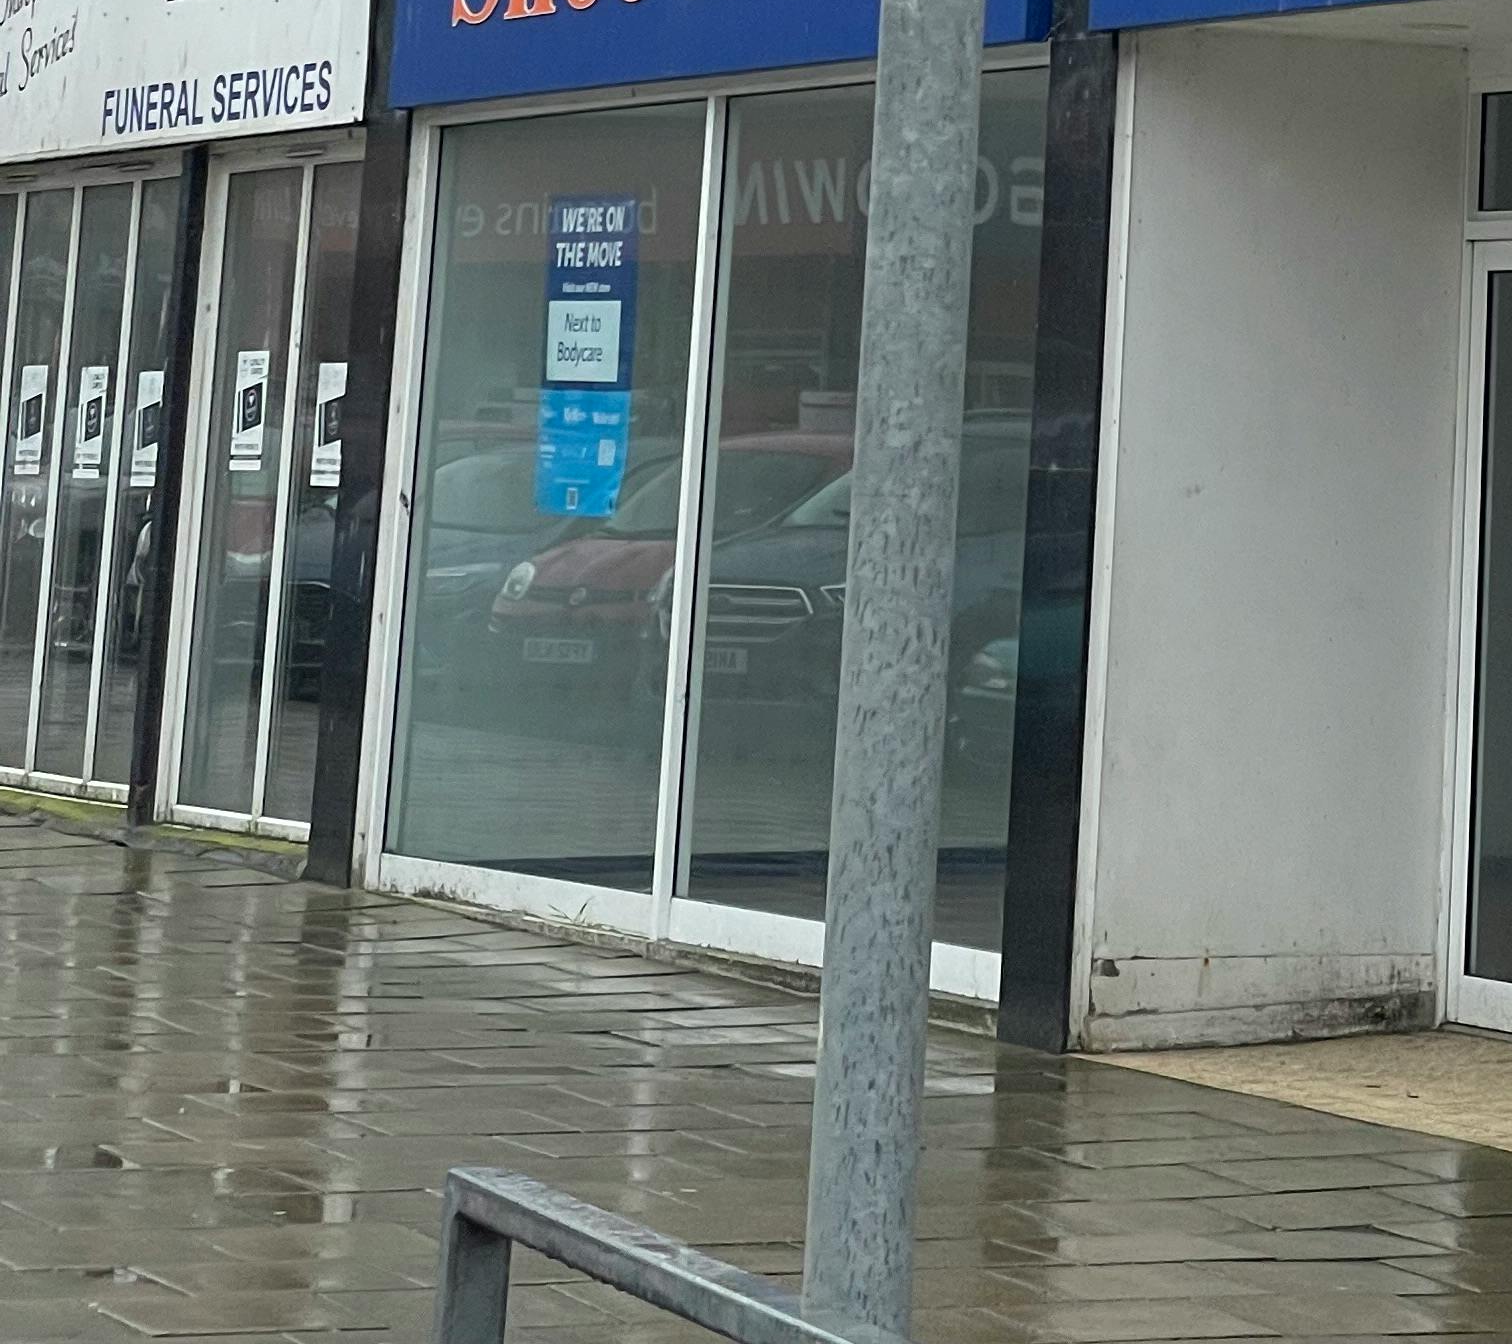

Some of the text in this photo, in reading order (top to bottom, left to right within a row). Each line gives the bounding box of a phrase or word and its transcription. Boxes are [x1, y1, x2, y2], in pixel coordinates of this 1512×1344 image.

[102, 60, 332, 136] FUNERAL SERVICES
[562, 207, 604, 233] WE'RE
[606, 206, 626, 232] ON
[556, 241, 623, 268] THE MOVE
[565, 313, 601, 333] Next to
[557, 342, 603, 367] Bodycare
